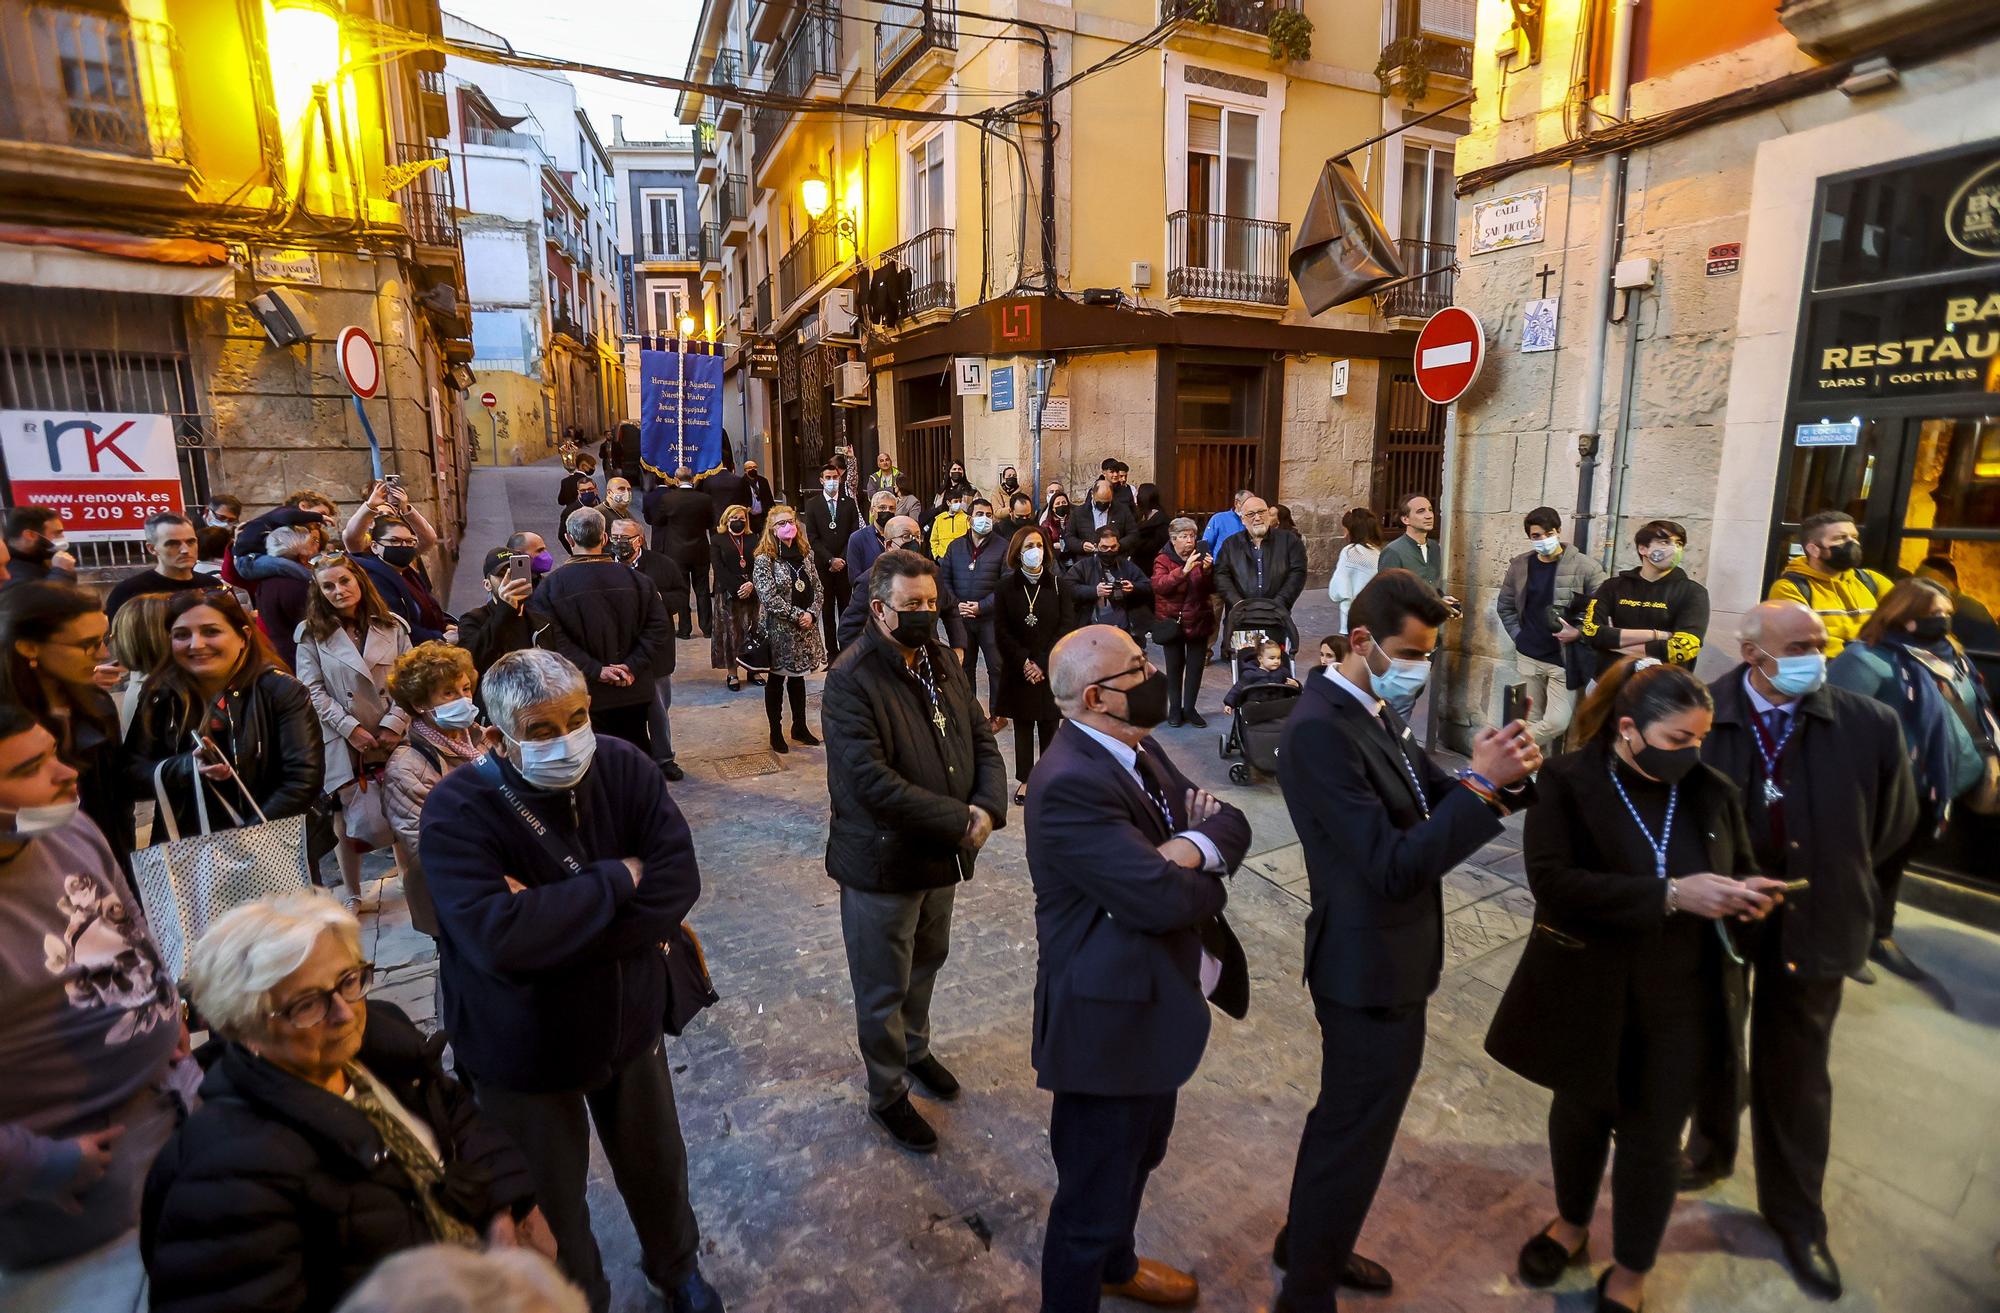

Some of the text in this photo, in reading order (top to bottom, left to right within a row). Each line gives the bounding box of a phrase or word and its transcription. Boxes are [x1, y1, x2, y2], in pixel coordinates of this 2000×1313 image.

[1495, 205, 1520, 217] CALLE
[752, 354, 778, 362] SENTO
[1819, 369, 1978, 389] TAPAS COCTELES
[28, 491, 170, 504] www.renovak.es
[84, 506, 123, 520] 209
[499, 783, 547, 836] POLITOURS
